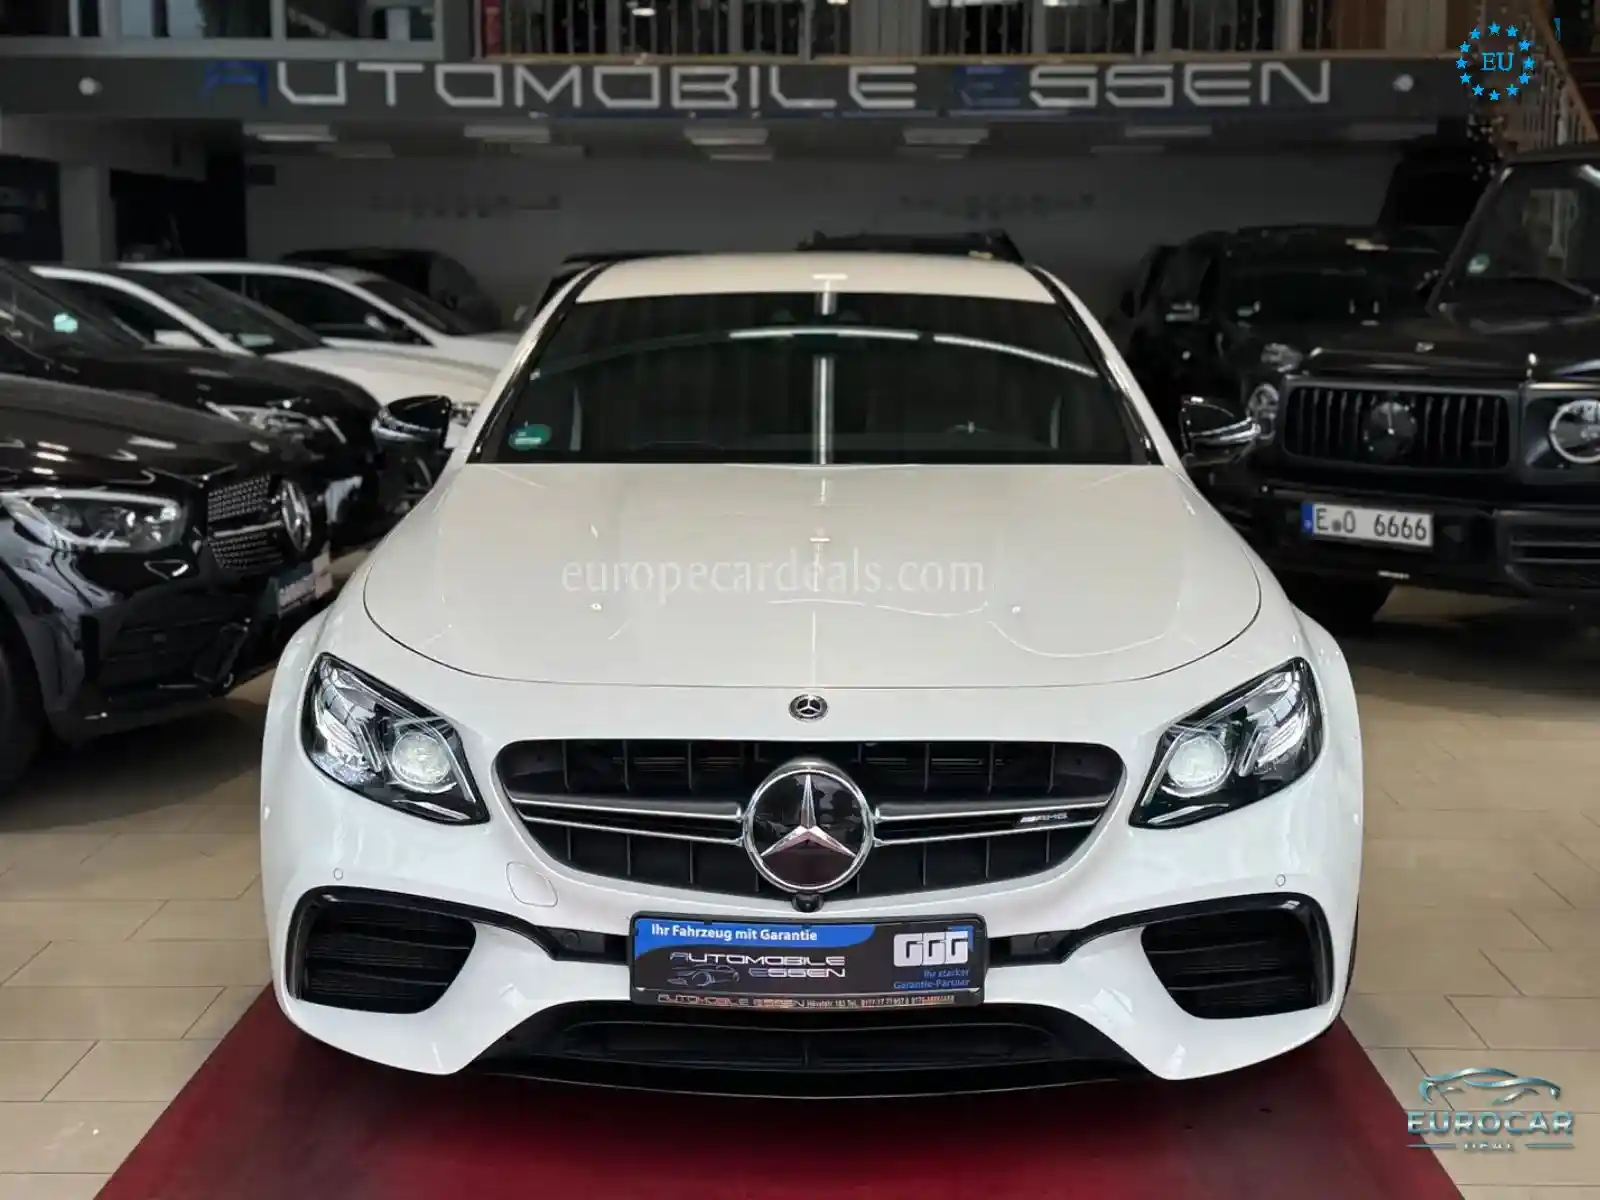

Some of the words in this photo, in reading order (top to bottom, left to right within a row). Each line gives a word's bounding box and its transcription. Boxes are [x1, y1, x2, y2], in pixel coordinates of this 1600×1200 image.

[204, 60, 918, 109] AUTOMOBILE
[953, 60, 1331, 109] ESSEN
[1373, 513, 1427, 541] 6666
[651, 923, 669, 936] Ihr
[671, 925, 733, 942] Fahrzeug
[735, 928, 757, 940] mit
[760, 929, 818, 942] Garantie
[669, 951, 846, 966] AUTOMOBILE
[748, 967, 846, 978] ESSEN
